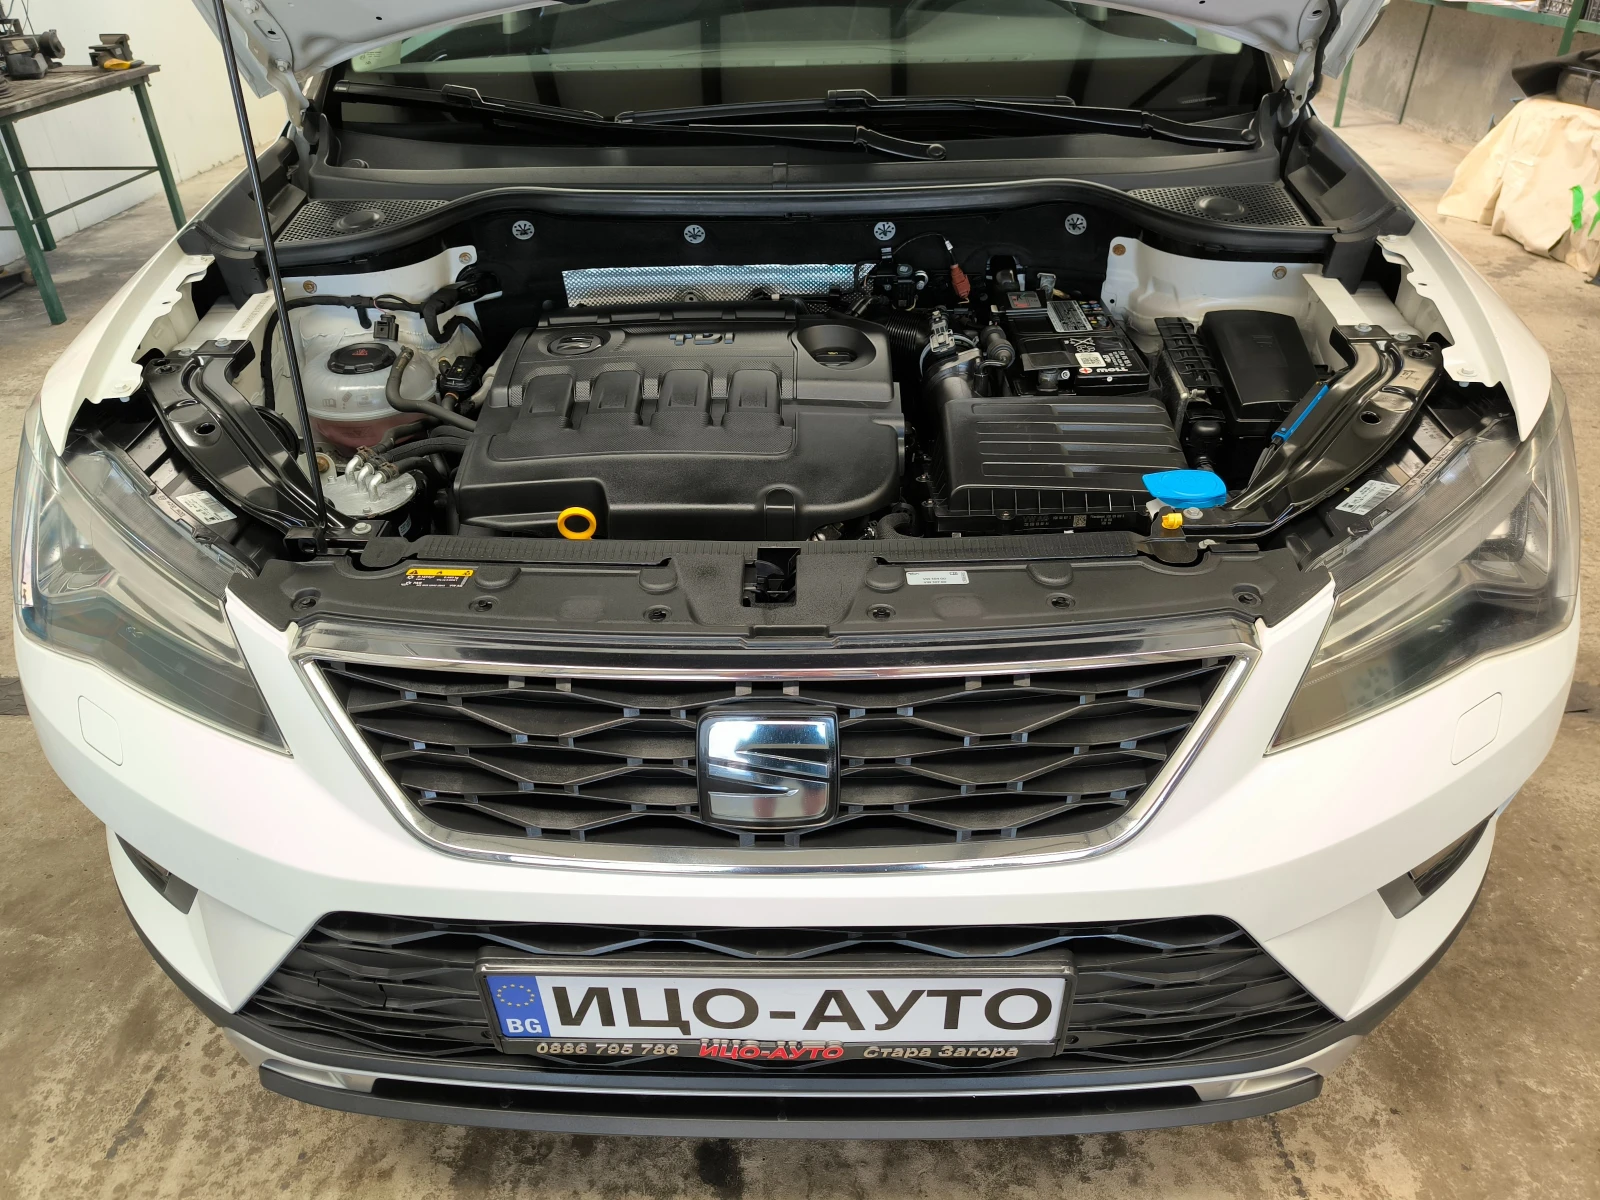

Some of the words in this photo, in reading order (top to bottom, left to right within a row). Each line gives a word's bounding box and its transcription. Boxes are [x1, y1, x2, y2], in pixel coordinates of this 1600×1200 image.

[669, 332, 735, 346] TDI
[552, 986, 1052, 1035] ИЦО-АУТО
[506, 1018, 542, 1034] BG
[536, 1042, 588, 1054] 0886
[595, 1043, 634, 1055] 795
[641, 1043, 679, 1055] 786
[699, 1042, 844, 1060] ИЦО-АУТО
[863, 1045, 932, 1058] Стара
[938, 1045, 1019, 1058] Загора
